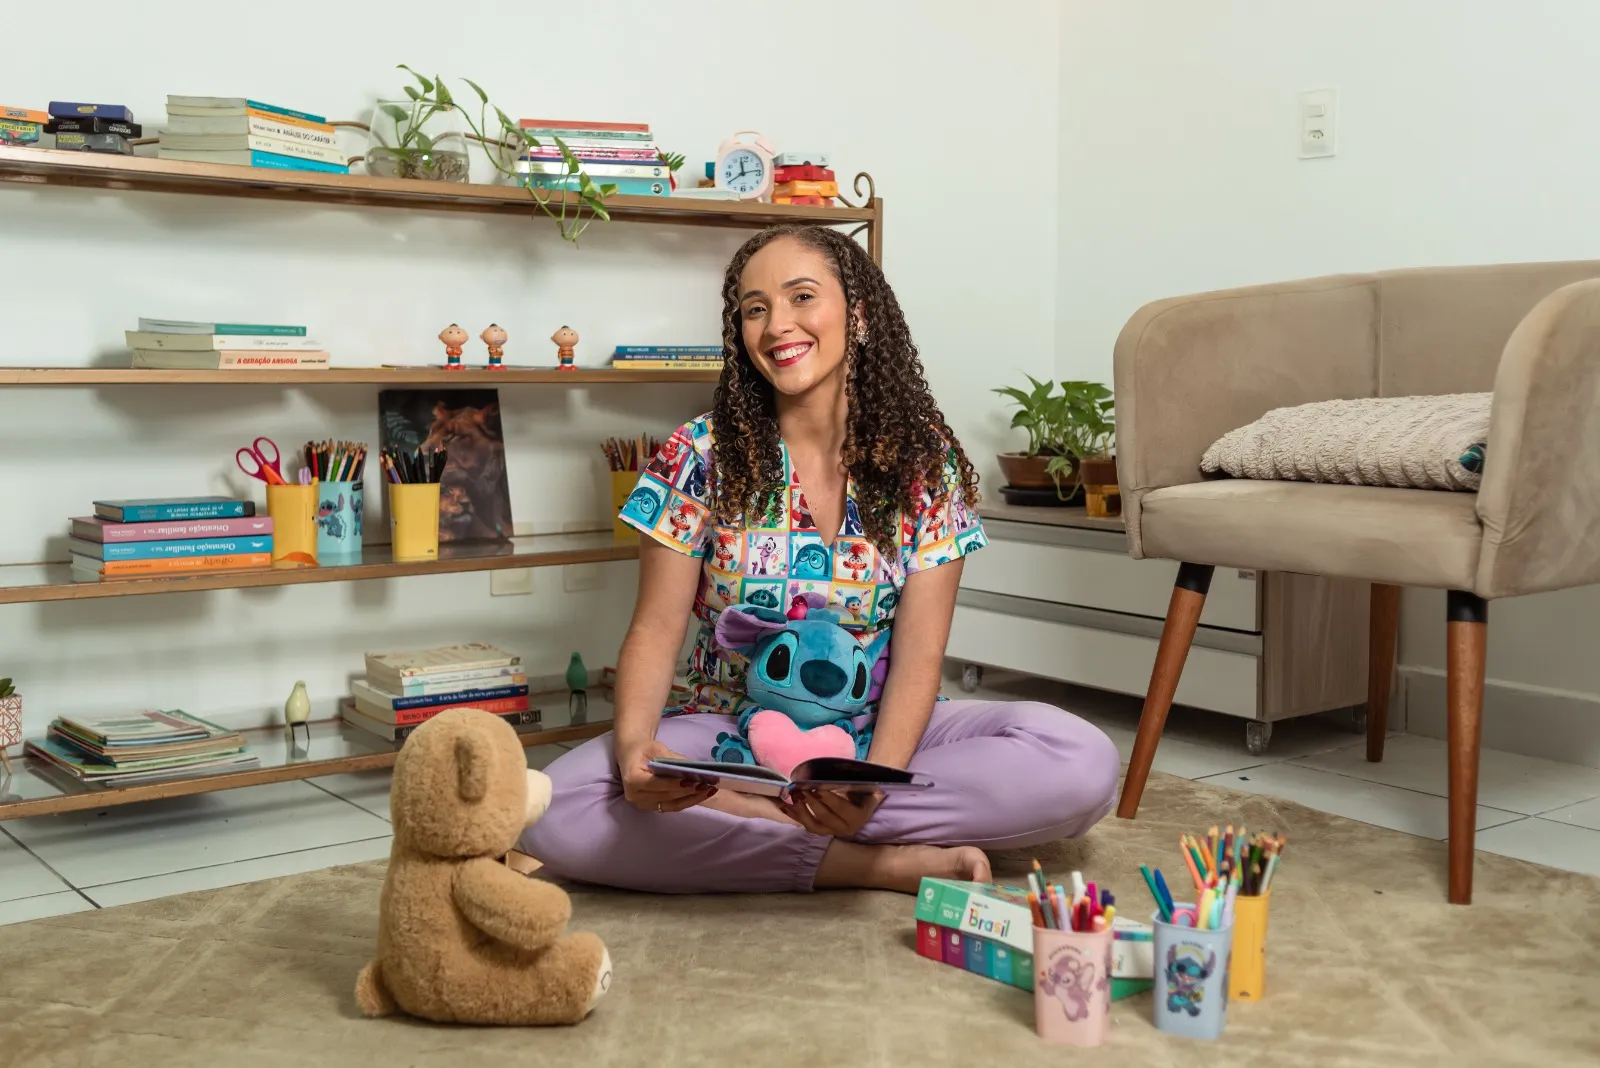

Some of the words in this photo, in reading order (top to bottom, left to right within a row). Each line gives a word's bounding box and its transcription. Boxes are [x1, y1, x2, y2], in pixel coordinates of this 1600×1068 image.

[242, 356, 271, 366] GERAÇÃO
[156, 527, 188, 536] familiar
[188, 525, 229, 536] Orientação
[164, 545, 195, 554] Familiar
[196, 543, 236, 554] Orientação
